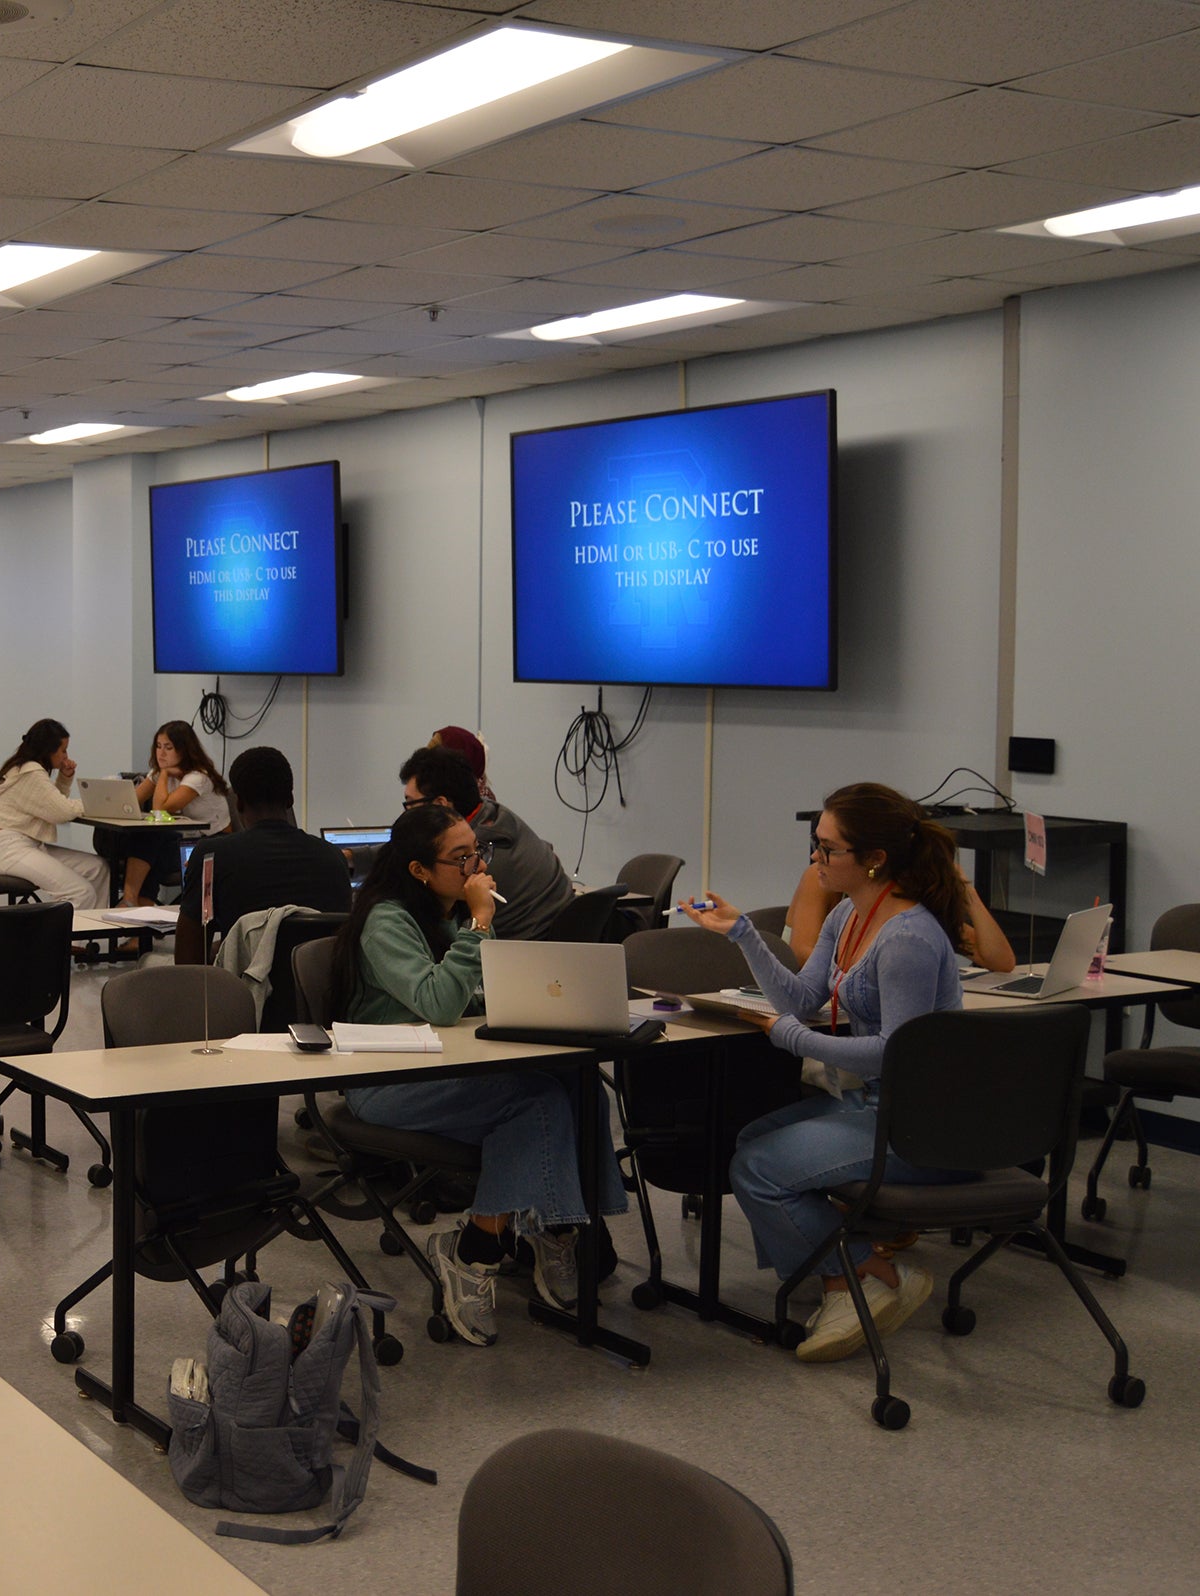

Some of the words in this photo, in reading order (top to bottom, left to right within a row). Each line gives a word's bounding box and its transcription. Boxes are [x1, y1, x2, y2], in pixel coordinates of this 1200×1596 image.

[570, 500, 637, 527] PLEASE
[645, 488, 764, 522] CONNECT
[186, 537, 226, 558] PLEASE
[230, 530, 299, 555] CONNECT
[575, 543, 618, 564] HDMI
[623, 545, 645, 561] OR
[705, 540, 726, 558] TO
[731, 538, 759, 557] USE
[189, 570, 216, 585] HDMI
[218, 570, 231, 583] OR
[266, 567, 279, 581] TO
[281, 566, 297, 580] USE
[615, 570, 648, 588] THIS
[653, 567, 711, 587] DISPLAY
[214, 590, 233, 602] THIS
[236, 587, 270, 601] DISPLAY
